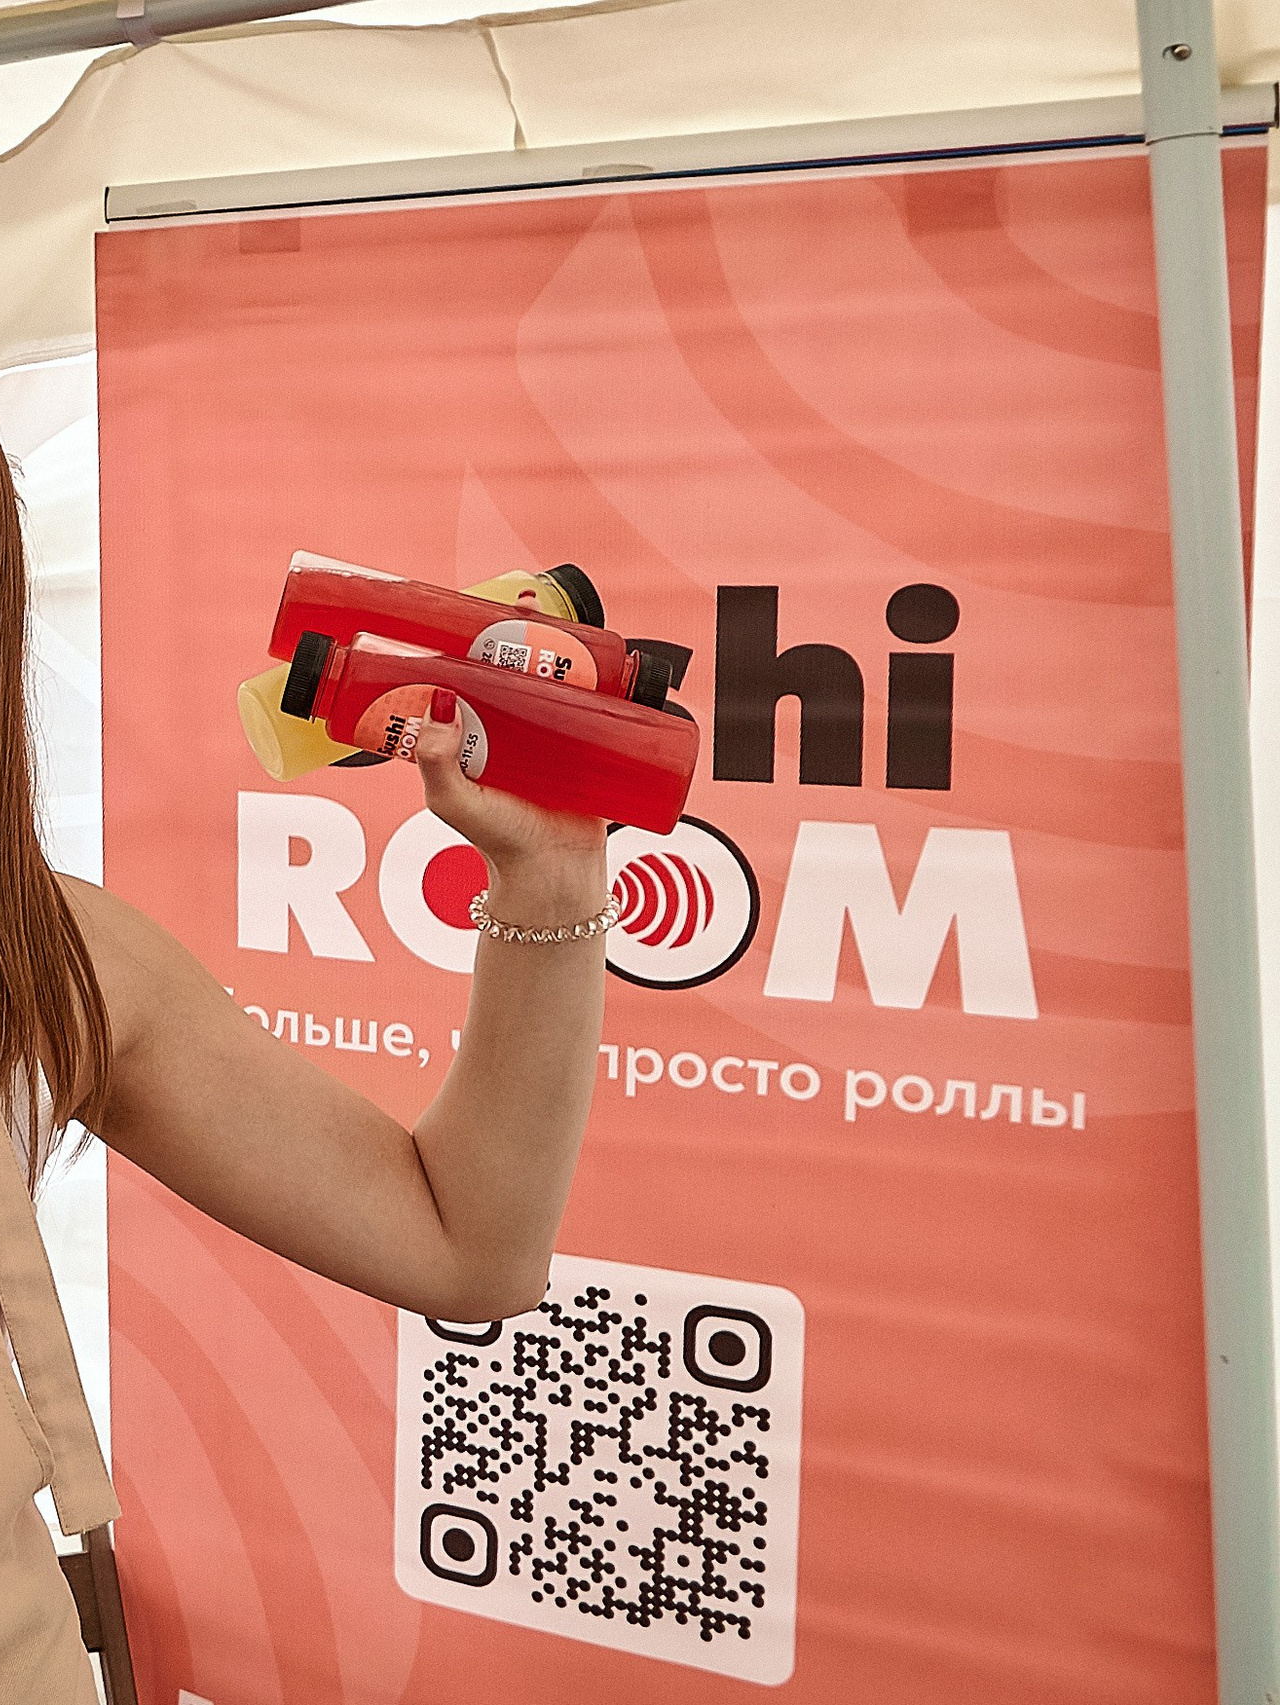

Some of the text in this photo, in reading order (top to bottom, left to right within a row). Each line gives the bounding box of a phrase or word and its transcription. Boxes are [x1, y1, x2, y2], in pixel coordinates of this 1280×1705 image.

[536, 649, 556, 678] RO
[397, 716, 423, 759] OOM
[237, 790, 1040, 1020] ROOM
[223, 987, 431, 1068] ольше,
[844, 1067, 1087, 1131] роллы
